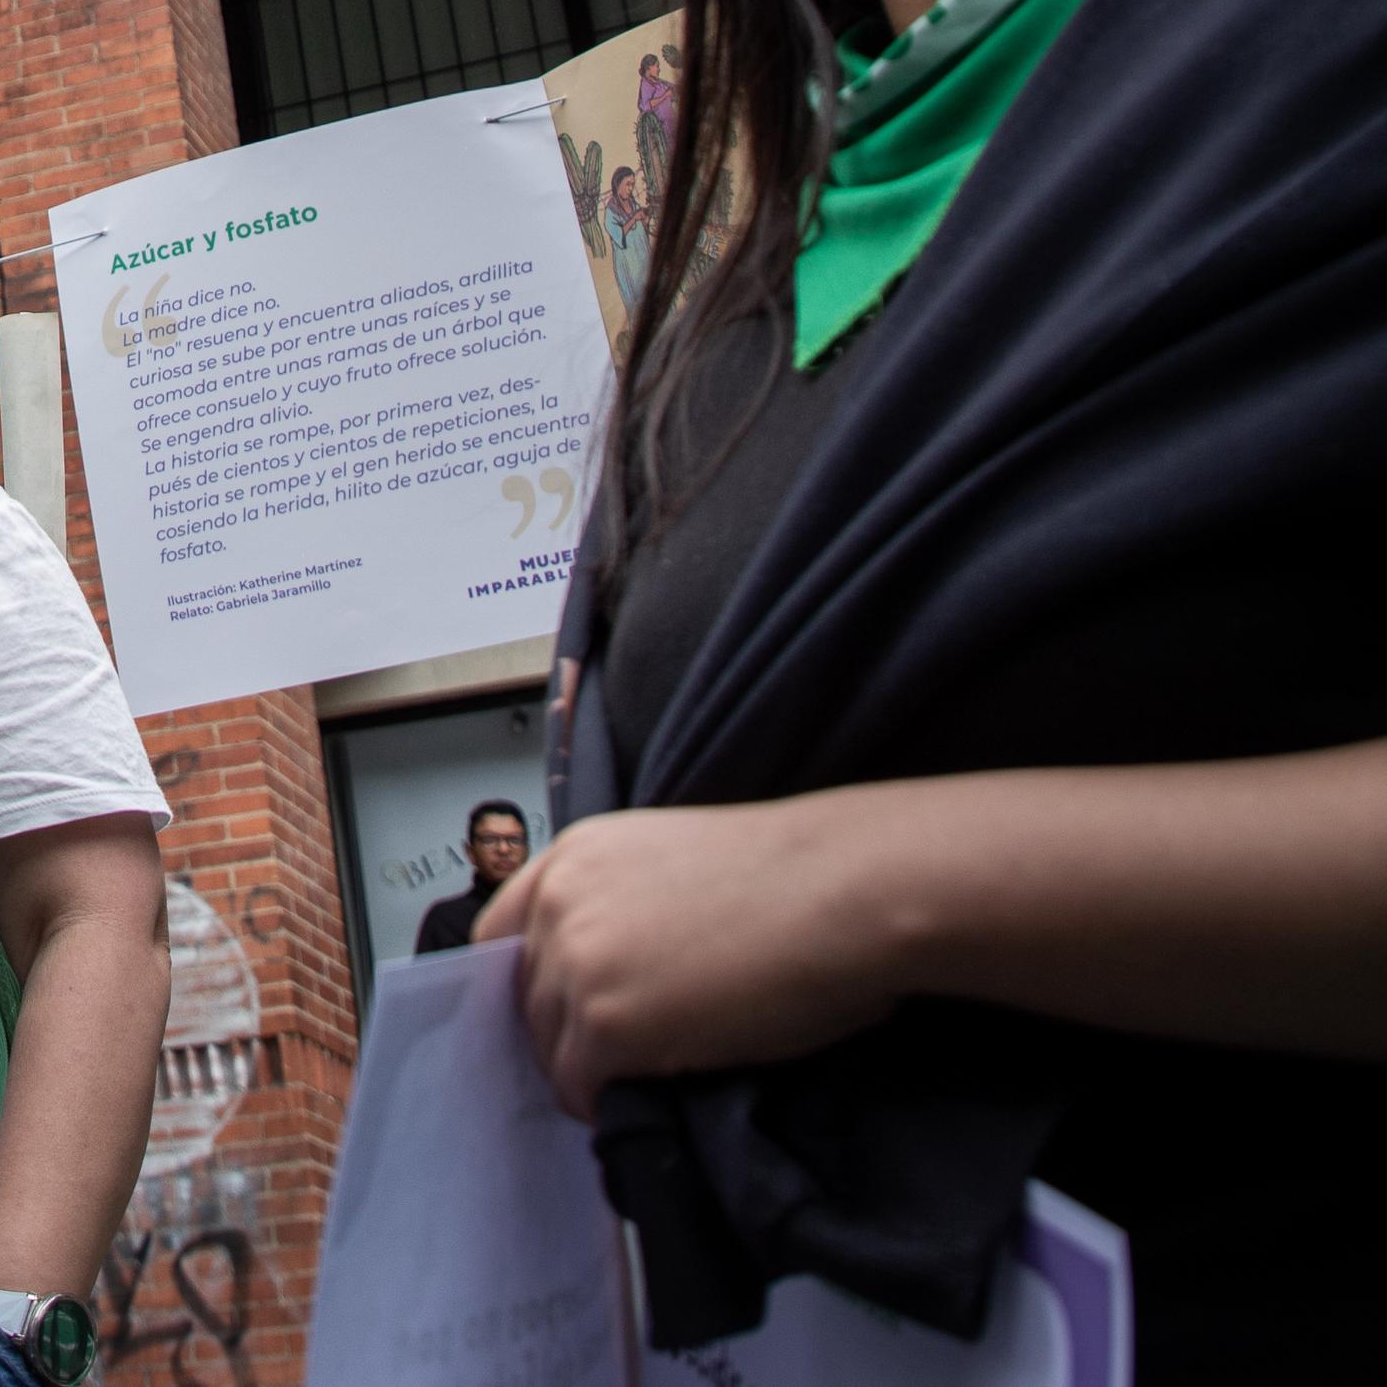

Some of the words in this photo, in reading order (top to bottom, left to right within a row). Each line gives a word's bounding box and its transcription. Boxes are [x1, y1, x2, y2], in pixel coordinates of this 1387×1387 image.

[110, 236, 195, 275] Azúcar
[225, 206, 318, 242] fosfato
[119, 308, 139, 326] La
[144, 299, 183, 320] niña
[187, 288, 225, 307] dice
[230, 281, 256, 297] no.
[123, 331, 142, 347] La
[148, 315, 206, 341] madre
[211, 305, 248, 324] dice
[254, 298, 280, 314] no.
[127, 350, 141, 368] El
[146, 340, 181, 362] "no"
[187, 324, 258, 353] resuena
[278, 297, 374, 330] encuentra
[380, 280, 454, 306] aliados,
[459, 261, 533, 288] ardillita
[129, 363, 193, 389] curiosa
[198, 357, 217, 372] se
[222, 345, 266, 366] sube
[271, 336, 302, 358] por
[306, 325, 356, 346] entre
[361, 312, 408, 333] unas
[413, 298, 470, 322] raíces
[490, 289, 511, 304] se
[133, 378, 218, 411] acomoda
[223, 367, 271, 389] entre
[276, 355, 322, 376] unas
[327, 340, 388, 364] ramas
[392, 332, 417, 349] de
[422, 327, 446, 343] un
[452, 309, 502, 336] árbol
[508, 305, 546, 326] que
[137, 409, 191, 432] ofrece
[196, 387, 277, 418] consuelo
[297, 374, 342, 394] cuyo
[346, 362, 392, 383] fruto
[397, 348, 457, 371] ofrece
[461, 328, 547, 357] solución.
[141, 438, 162, 454] Se
[166, 416, 254, 447] engendra
[259, 402, 313, 426] alivio.
[145, 460, 166, 476] La
[172, 441, 238, 470] historia
[243, 438, 264, 453] se
[269, 423, 334, 447] rompe,
[340, 413, 371, 435] por
[377, 395, 453, 427] primera
[458, 387, 494, 405] vez,
[499, 377, 541, 395] des-
[149, 475, 192, 502] pués
[196, 469, 219, 486] de
[223, 454, 290, 480] cientos
[309, 435, 378, 461] cientos
[382, 427, 407, 445] de
[412, 402, 535, 439] repeticiones,
[541, 394, 558, 411] la
[153, 492, 219, 520] historia
[225, 488, 245, 503] se
[250, 473, 311, 498] rompe
[331, 461, 347, 479] el
[353, 456, 389, 479] gen
[395, 440, 457, 466] herido
[462, 436, 483, 451] se
[488, 412, 590, 445] encuentra
[156, 511, 237, 542] cosiendo
[243, 506, 259, 523] la
[265, 492, 329, 518] herida,
[335, 481, 382, 503] hilito
[387, 473, 412, 491] de
[416, 459, 488, 485] azúcar,
[493, 443, 550, 470] aguja
[556, 437, 581, 455] de
[160, 540, 227, 564] fosfato.
[167, 584, 237, 607] Ilustración:
[239, 570, 302, 591] Katherine
[305, 557, 363, 577] Martínez
[467, 568, 574, 599] IMPARABL
[169, 605, 214, 622] Relato:
[216, 592, 269, 612] Gabriela
[271, 579, 331, 601] Jaramillo
